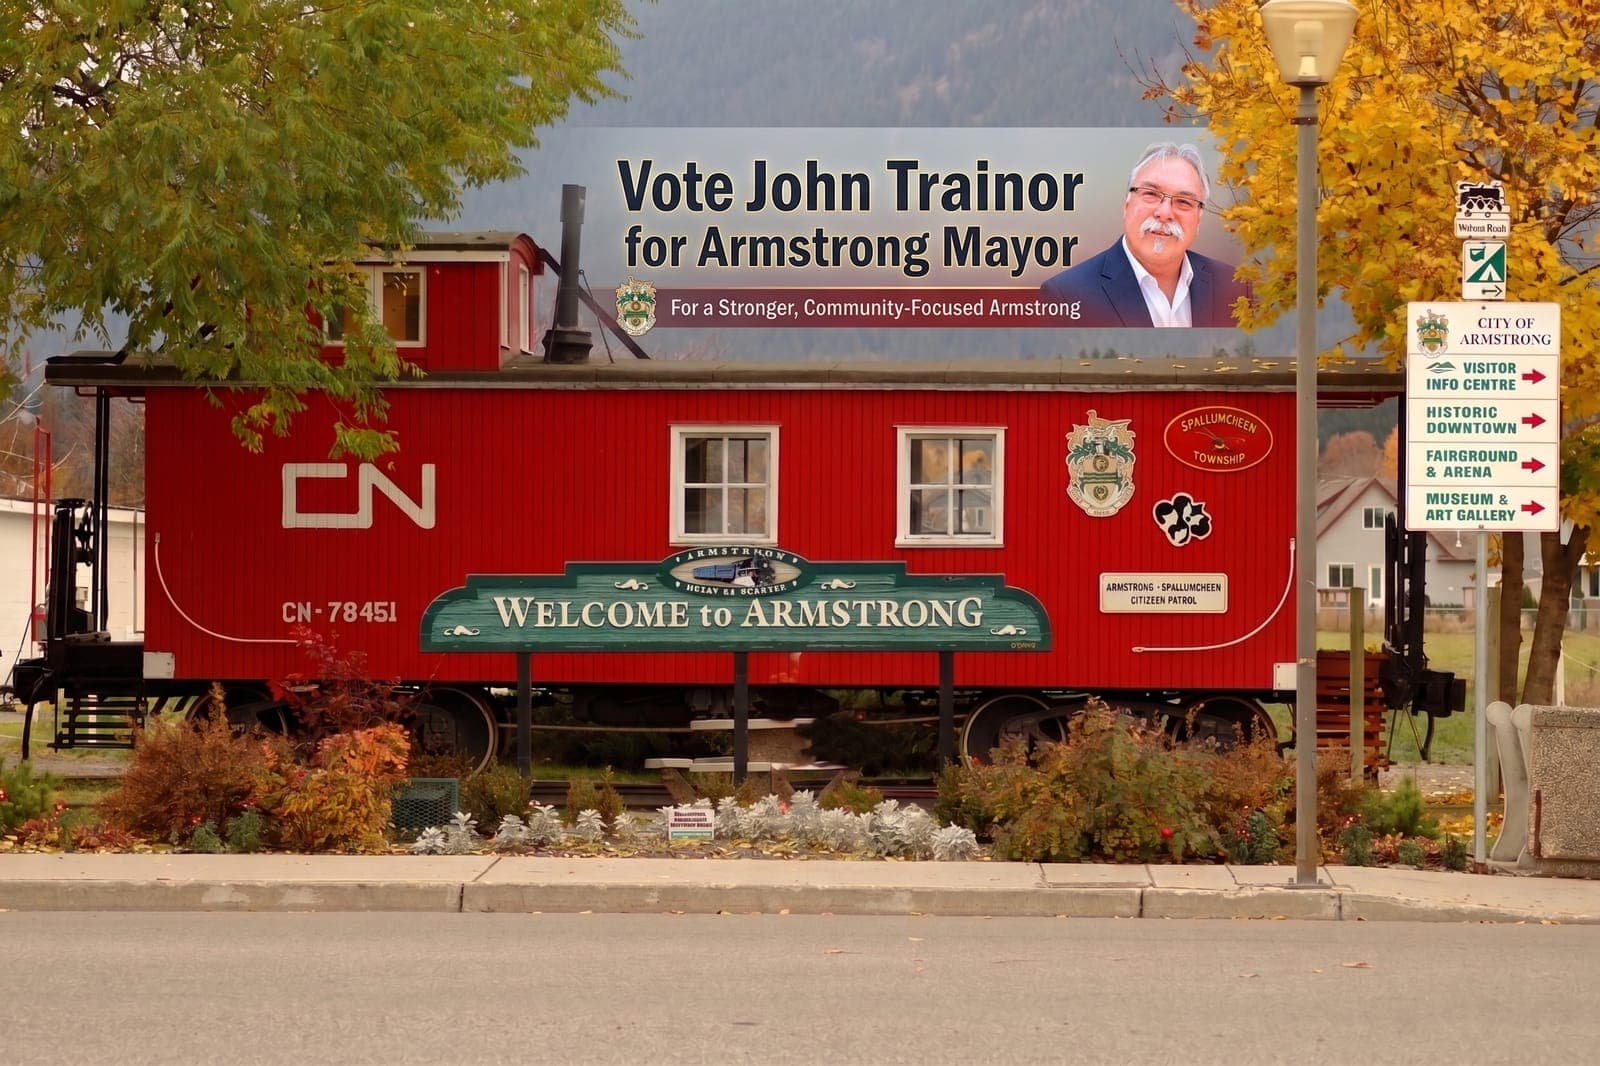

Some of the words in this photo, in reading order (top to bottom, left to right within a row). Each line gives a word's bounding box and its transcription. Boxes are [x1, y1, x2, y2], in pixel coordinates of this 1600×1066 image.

[616, 160, 734, 212] Vote
[746, 160, 870, 212] John
[886, 160, 1084, 212] Trainor
[624, 225, 687, 267] for
[697, 226, 930, 278] Armstrong
[943, 226, 1078, 278] Mayor
[671, 299, 698, 316] For
[703, 304, 713, 316] a
[718, 299, 799, 319] Stronger,
[804, 299, 983, 319] Community-Focused
[989, 299, 1080, 319] Armstrong
[1478, 318, 1512, 329] CITY
[1515, 318, 1535, 329] OF
[1460, 334, 1552, 345] ARMSTRONG
[1463, 362, 1516, 374] VISITOR
[1427, 378, 1459, 390] INFO
[1463, 379, 1516, 391] CENTRE
[1427, 407, 1498, 418] HISTORIC
[1181, 413, 1257, 434] SPALLUMCHEEN
[1427, 422, 1517, 434] DOWNTOWN
[1193, 450, 1246, 465] TOWNSHIP
[1426, 450, 1518, 462] FAIRGROUND
[1426, 466, 1436, 478] &
[1444, 466, 1492, 478] ARENA
[282, 463, 436, 529] CN
[1426, 493, 1493, 505] MUSEUM
[1499, 495, 1508, 505] &
[1426, 509, 1453, 521] ART
[1457, 510, 1516, 521] GALLERY
[1161, 583, 1222, 592] SPALLUMCHEEN
[1168, 596, 1197, 605] PATROL
[494, 596, 689, 628] WELCOME
[700, 603, 732, 627] to
[740, 597, 984, 627] ARMSTRONG
